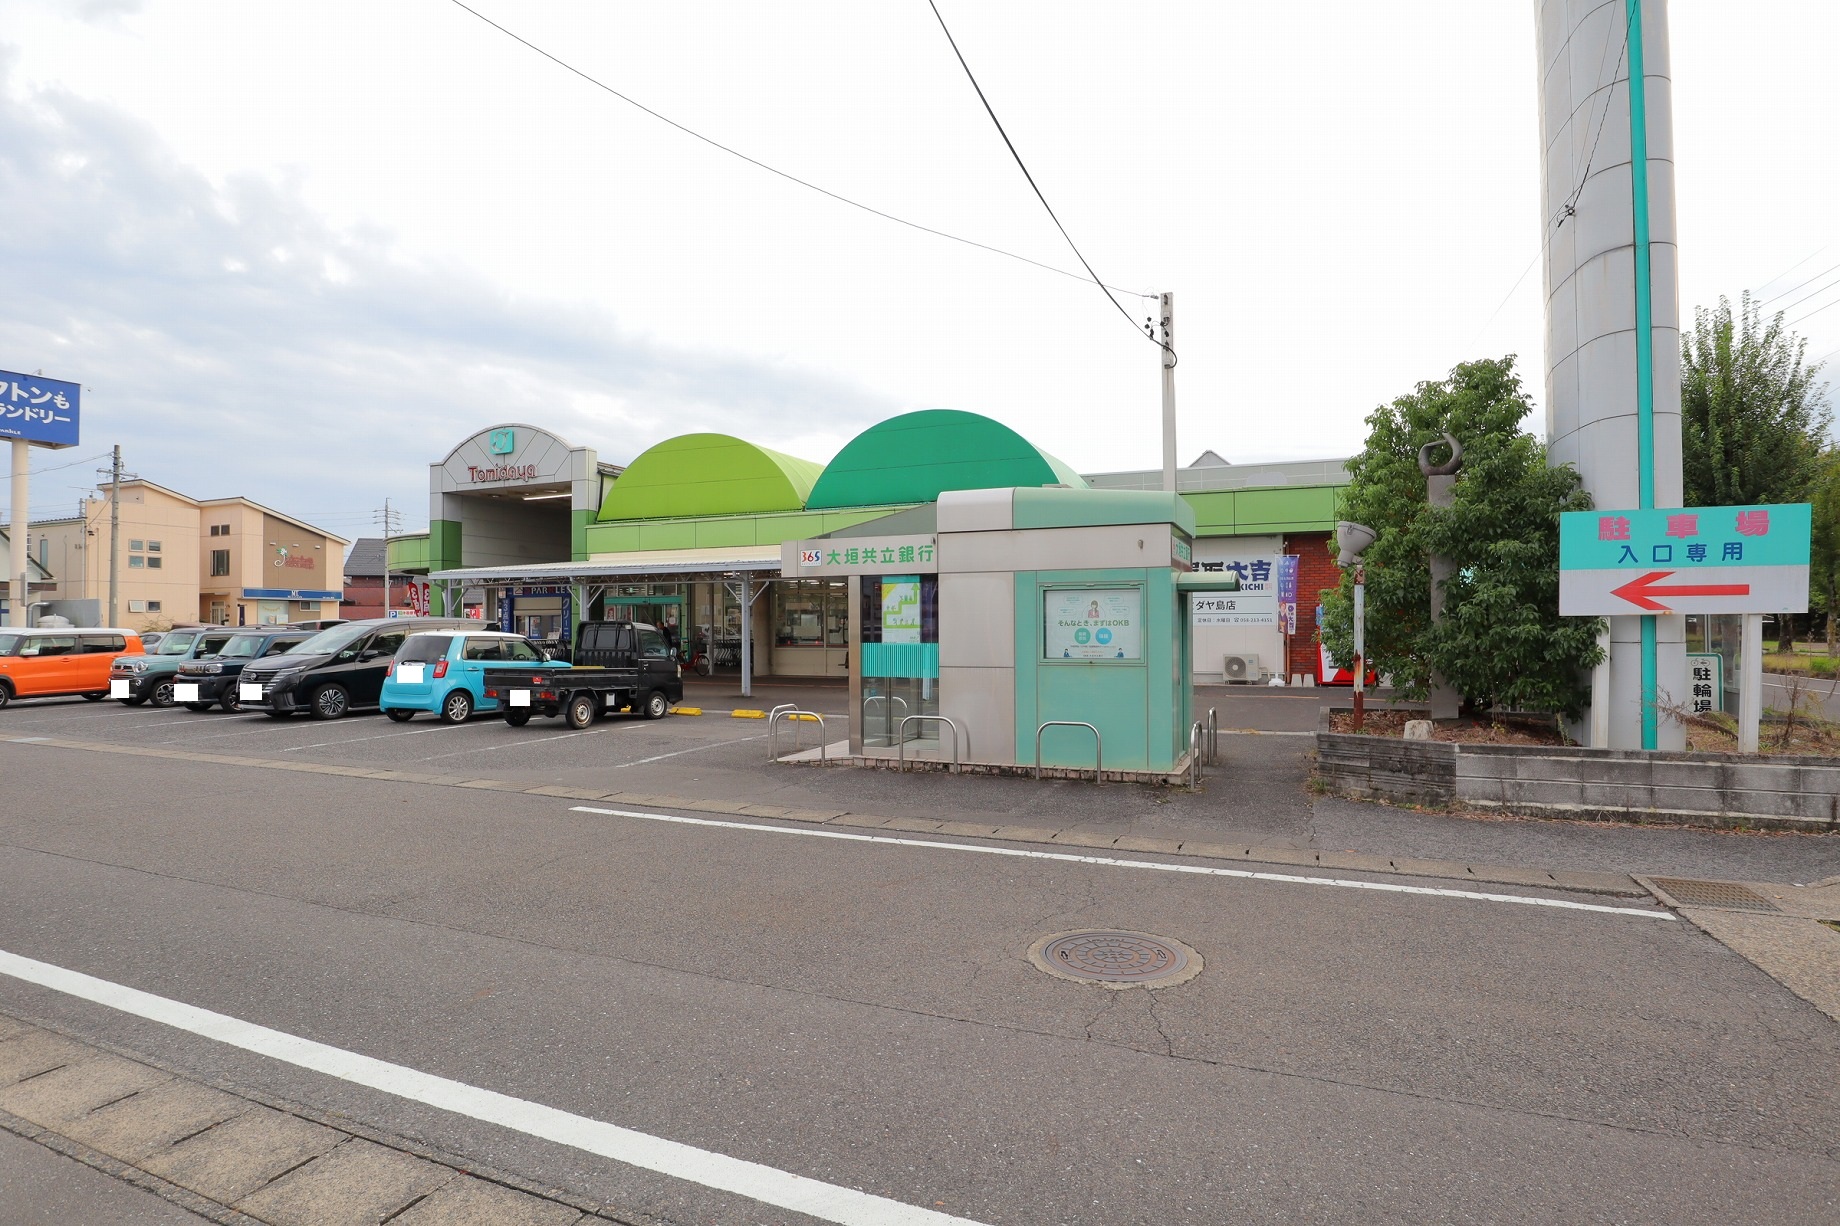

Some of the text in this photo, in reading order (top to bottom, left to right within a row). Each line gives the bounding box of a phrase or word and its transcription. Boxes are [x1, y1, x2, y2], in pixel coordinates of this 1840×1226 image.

[468, 463, 537, 482] Tomidaya
[1598, 510, 1770, 541] 駐車場
[801, 550, 821, 563] 365
[826, 544, 934, 565] 大垣共立銀行
[1618, 542, 1743, 563] 入口専用
[1193, 600, 1236, 611] ダヤ島店
[1693, 667, 1712, 713] 駐輪場
